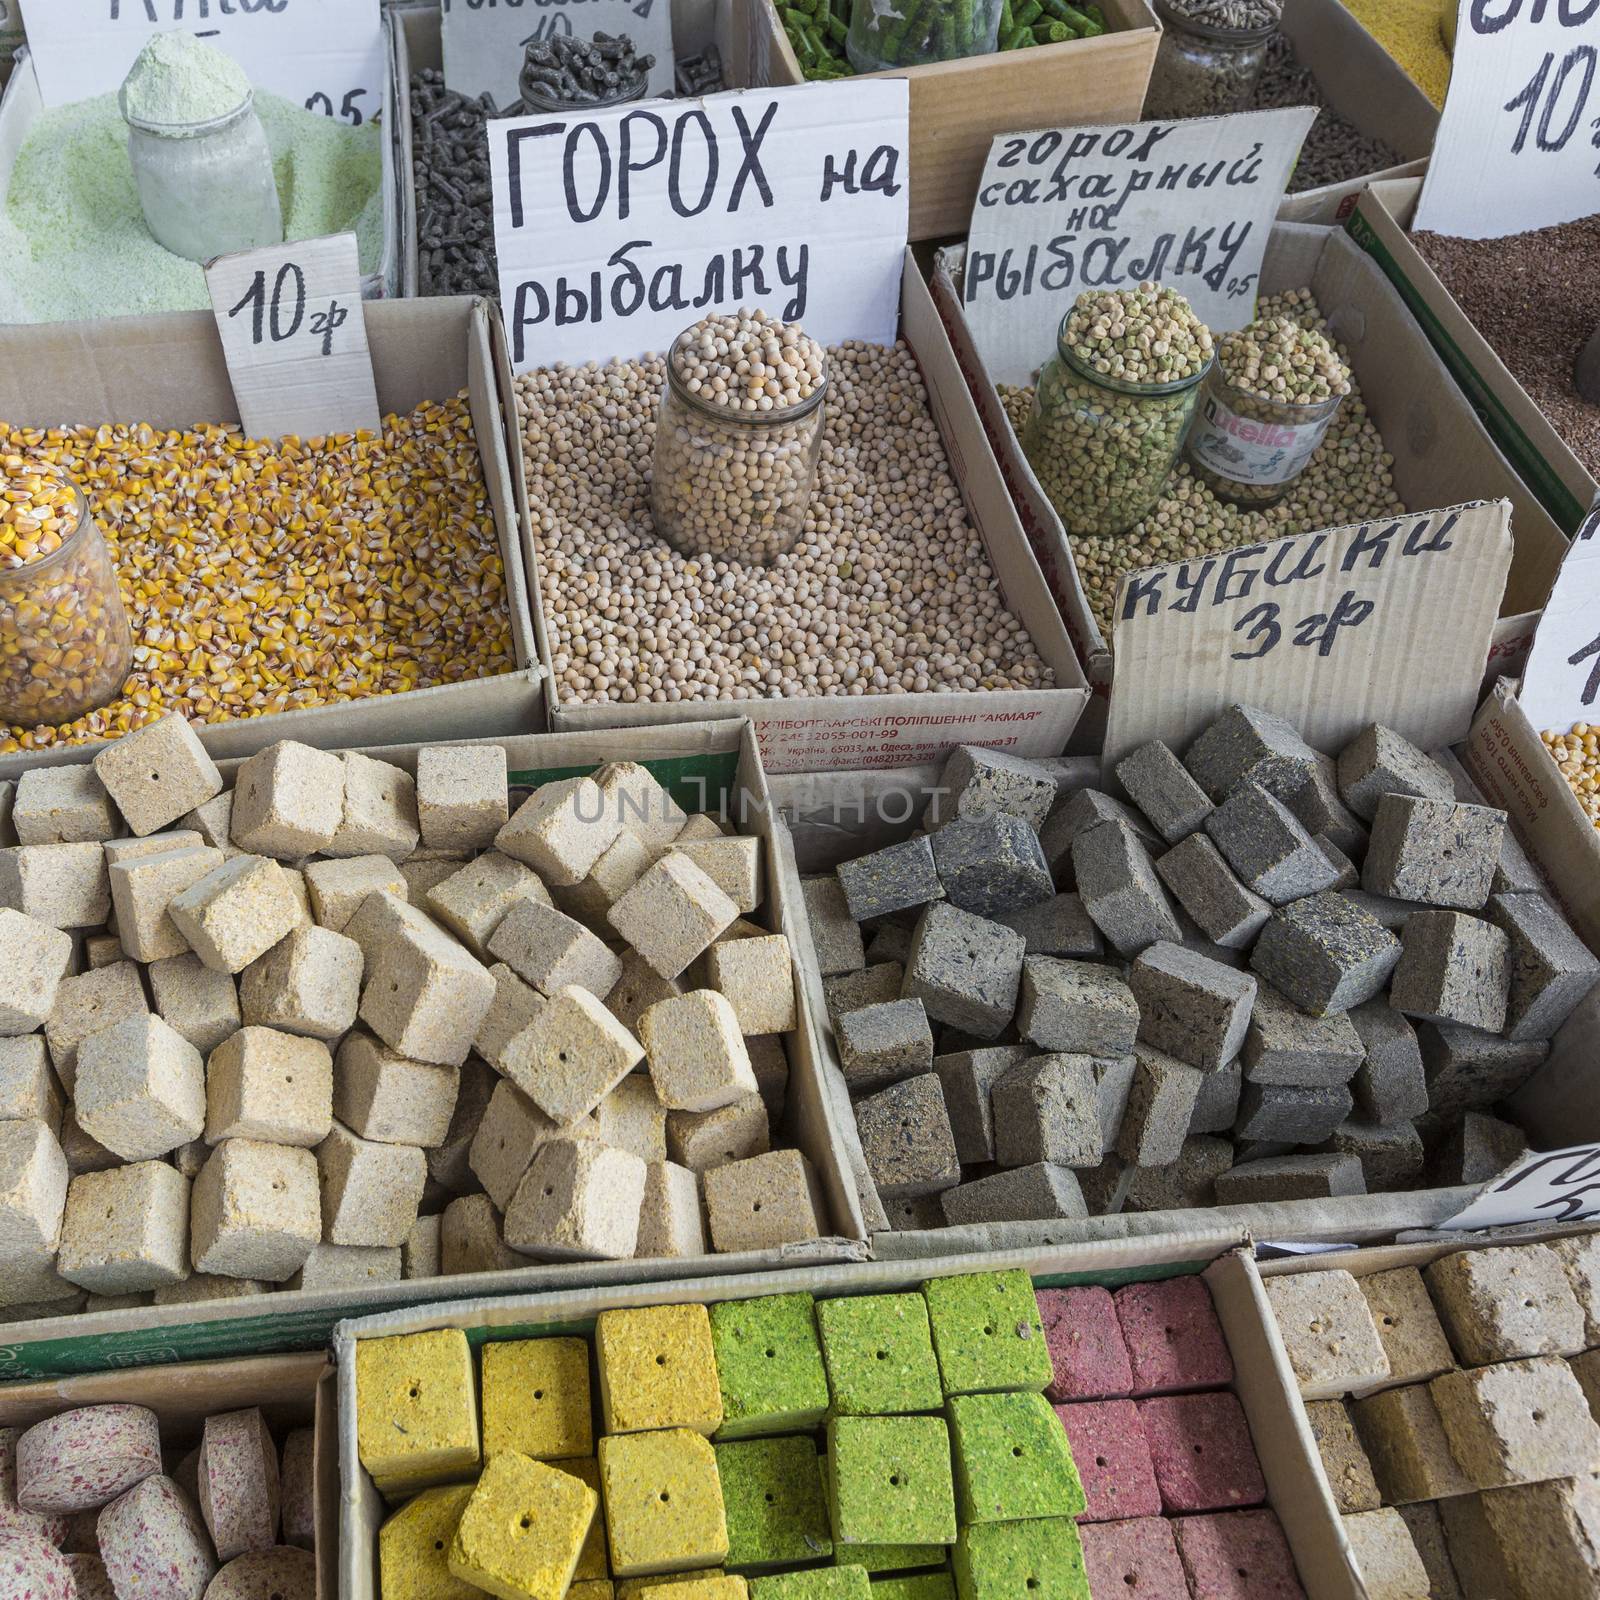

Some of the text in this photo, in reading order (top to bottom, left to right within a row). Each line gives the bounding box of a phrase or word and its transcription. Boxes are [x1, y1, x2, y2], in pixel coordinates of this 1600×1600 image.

[1503, 45, 1598, 155] 10
[507, 101, 901, 228] ГОРОХ на
[979, 142, 1263, 214] сахарный
[1066, 204, 1120, 231] на
[512, 240, 809, 363] рыбалку
[1121, 513, 1462, 621] КУБИКИ
[1230, 602, 1282, 660] 3
